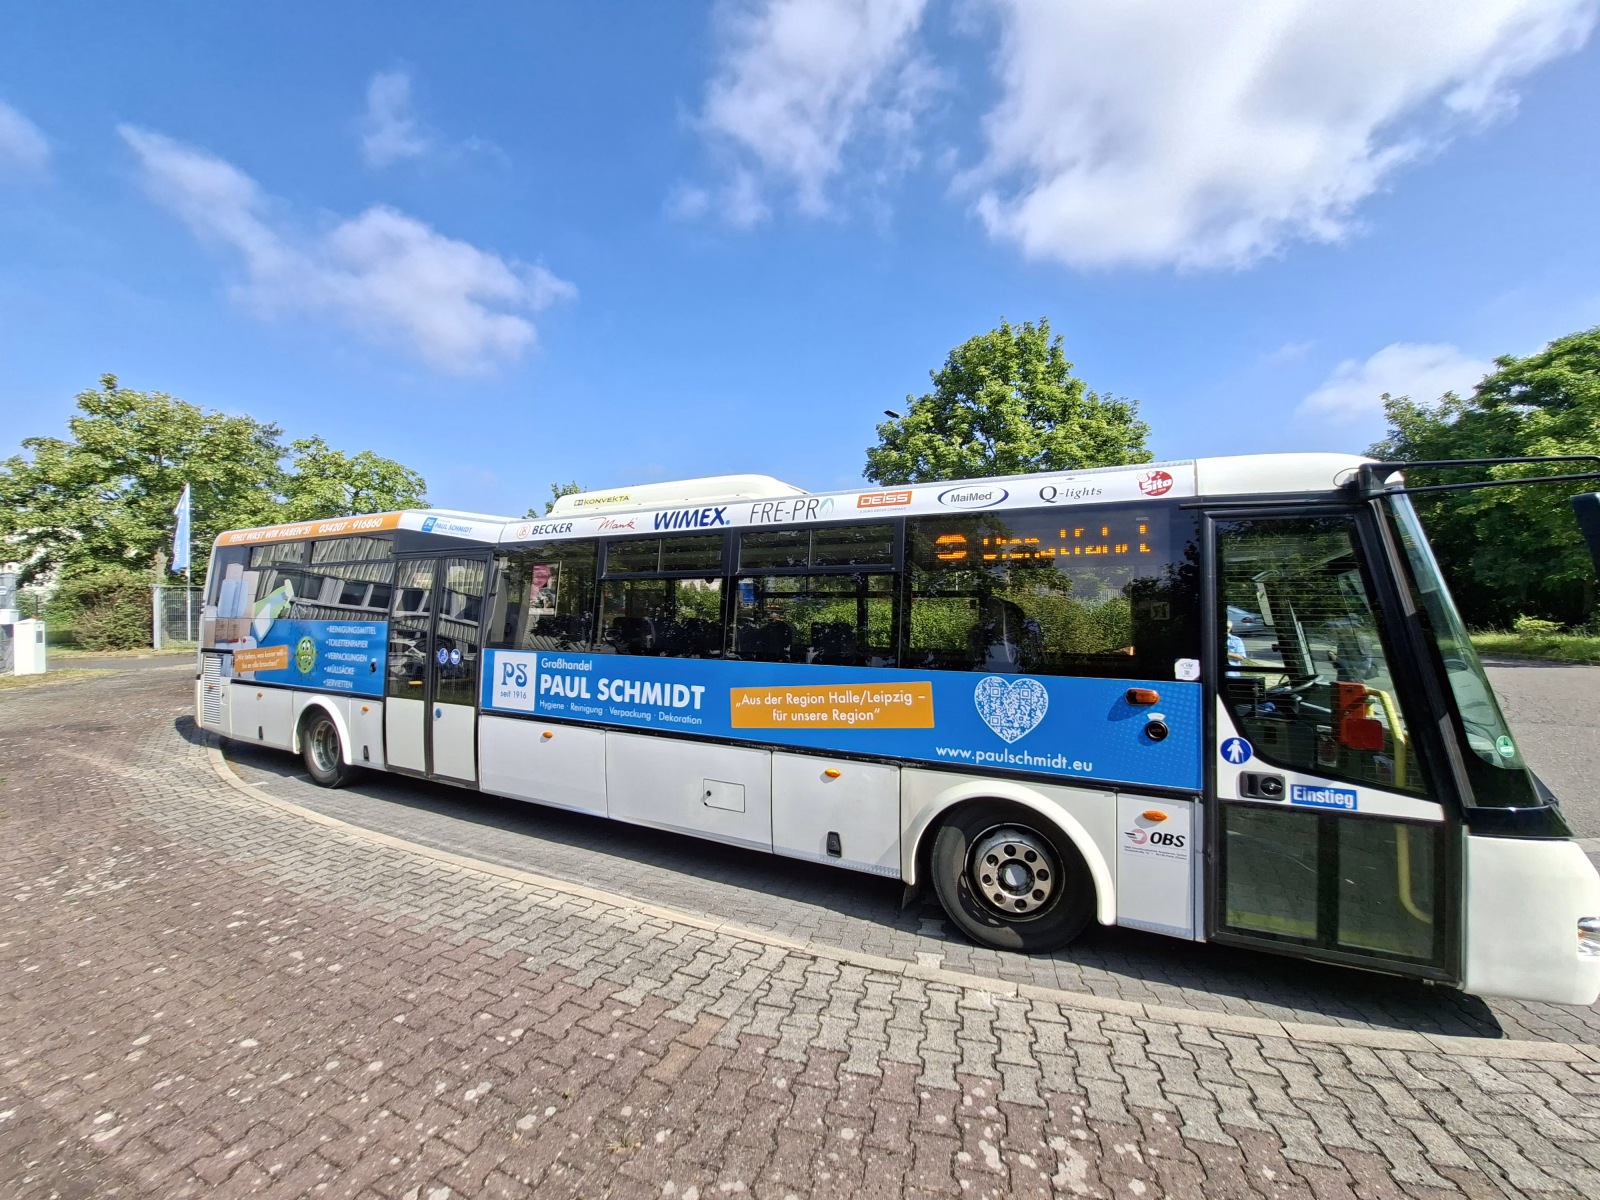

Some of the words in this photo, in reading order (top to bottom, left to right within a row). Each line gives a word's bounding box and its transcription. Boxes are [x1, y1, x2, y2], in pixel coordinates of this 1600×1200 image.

[584, 495, 630, 505] KONVEKTA
[860, 492, 909, 506] DEISS
[950, 492, 993, 502] MaiMed
[1039, 486, 1102, 503] Q-lights
[265, 528, 278, 539] WIR
[532, 522, 573, 535] BECKER
[541, 657, 592, 672] Großhandel
[501, 662, 528, 688] PS
[500, 690, 511, 698] seit
[513, 690, 527, 700] 1916
[539, 673, 591, 699] PAUL
[597, 677, 705, 710] SCHMIDT
[764, 692, 783, 705] der
[786, 692, 825, 708] Region
[828, 689, 913, 706] Halle/Leipzig
[539, 699, 565, 711] Hygiene
[570, 702, 603, 716] Reinigung
[609, 706, 652, 722] Verpackung
[658, 711, 703, 725] Dekoration
[772, 708, 788, 721] für
[791, 711, 828, 721] unsere
[935, 746, 1093, 772] www.paulschmidt.eu
[1292, 786, 1354, 809] Einstieg
[1150, 831, 1187, 848] OBS
